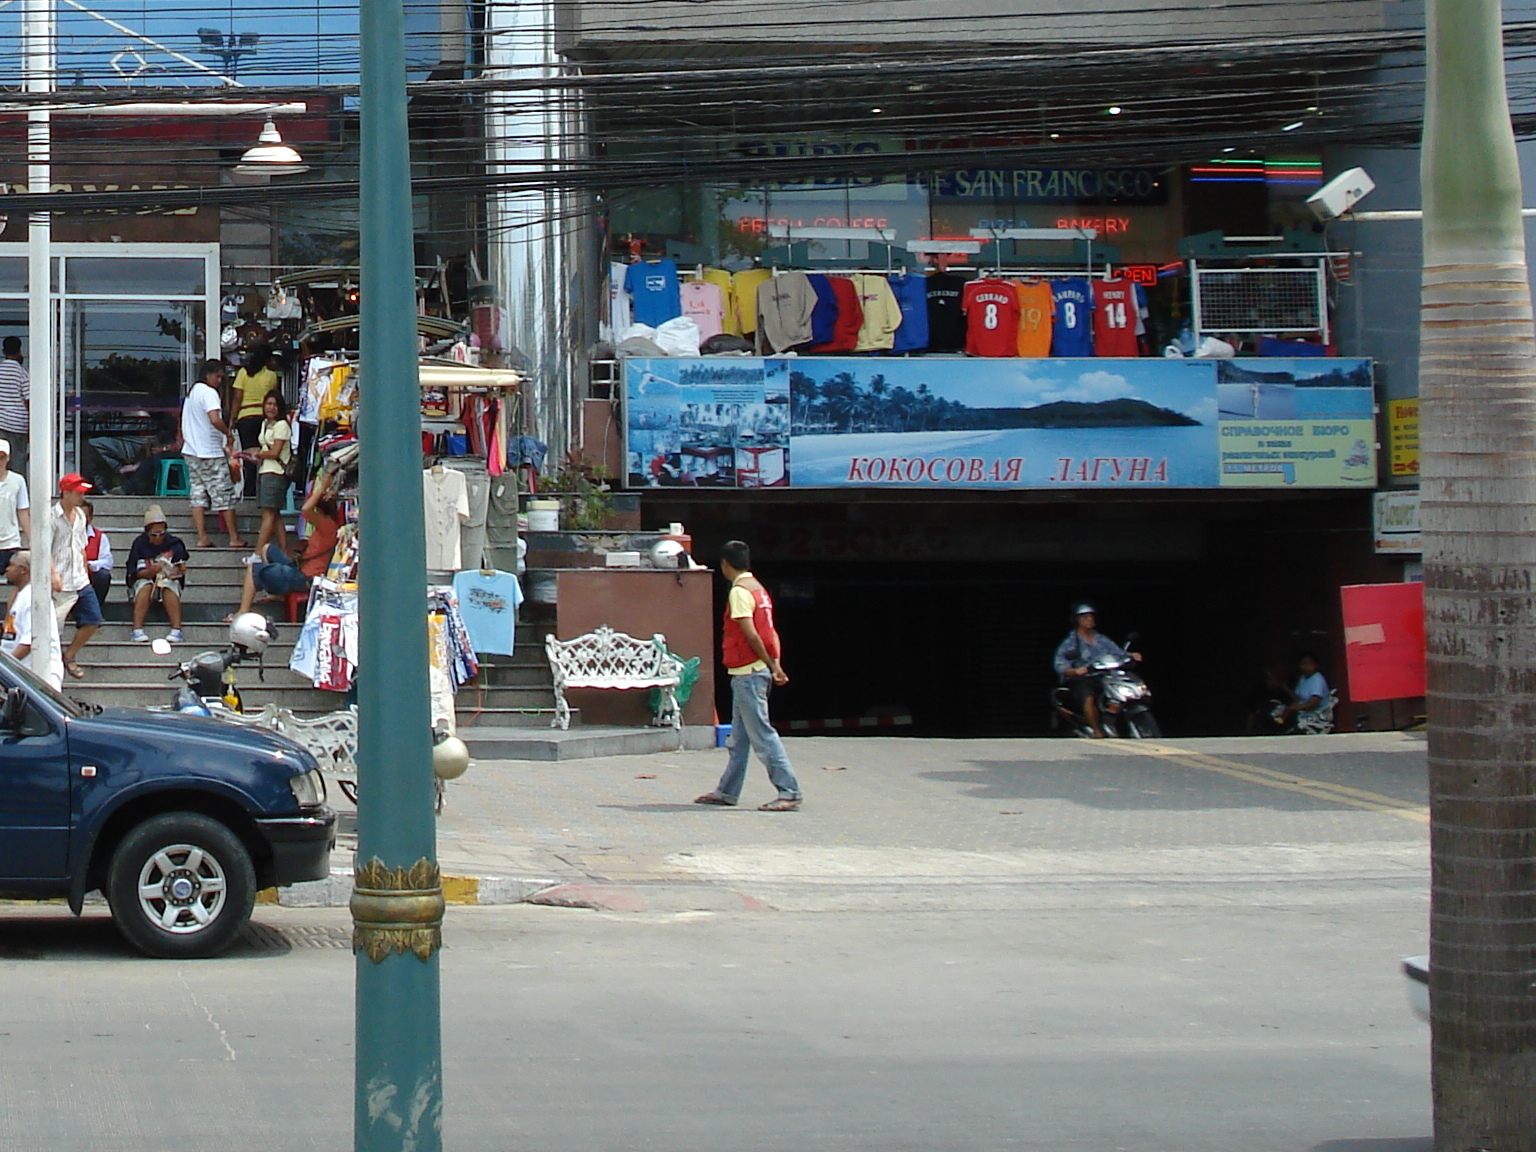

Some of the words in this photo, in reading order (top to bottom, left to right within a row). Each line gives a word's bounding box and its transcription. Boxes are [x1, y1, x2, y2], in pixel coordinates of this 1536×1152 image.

[955, 169, 1006, 197] SAN
[1013, 169, 1153, 198] FRANCISCO
[1056, 217, 1130, 233] BAKERY
[984, 303, 998, 329] 8
[1020, 307, 1042, 332] 19
[1064, 301, 1077, 329] 8
[1104, 302, 1127, 329] 14
[847, 457, 1023, 482] КОКОСОВАЯ
[1049, 457, 1169, 482] ЛАГУНА
